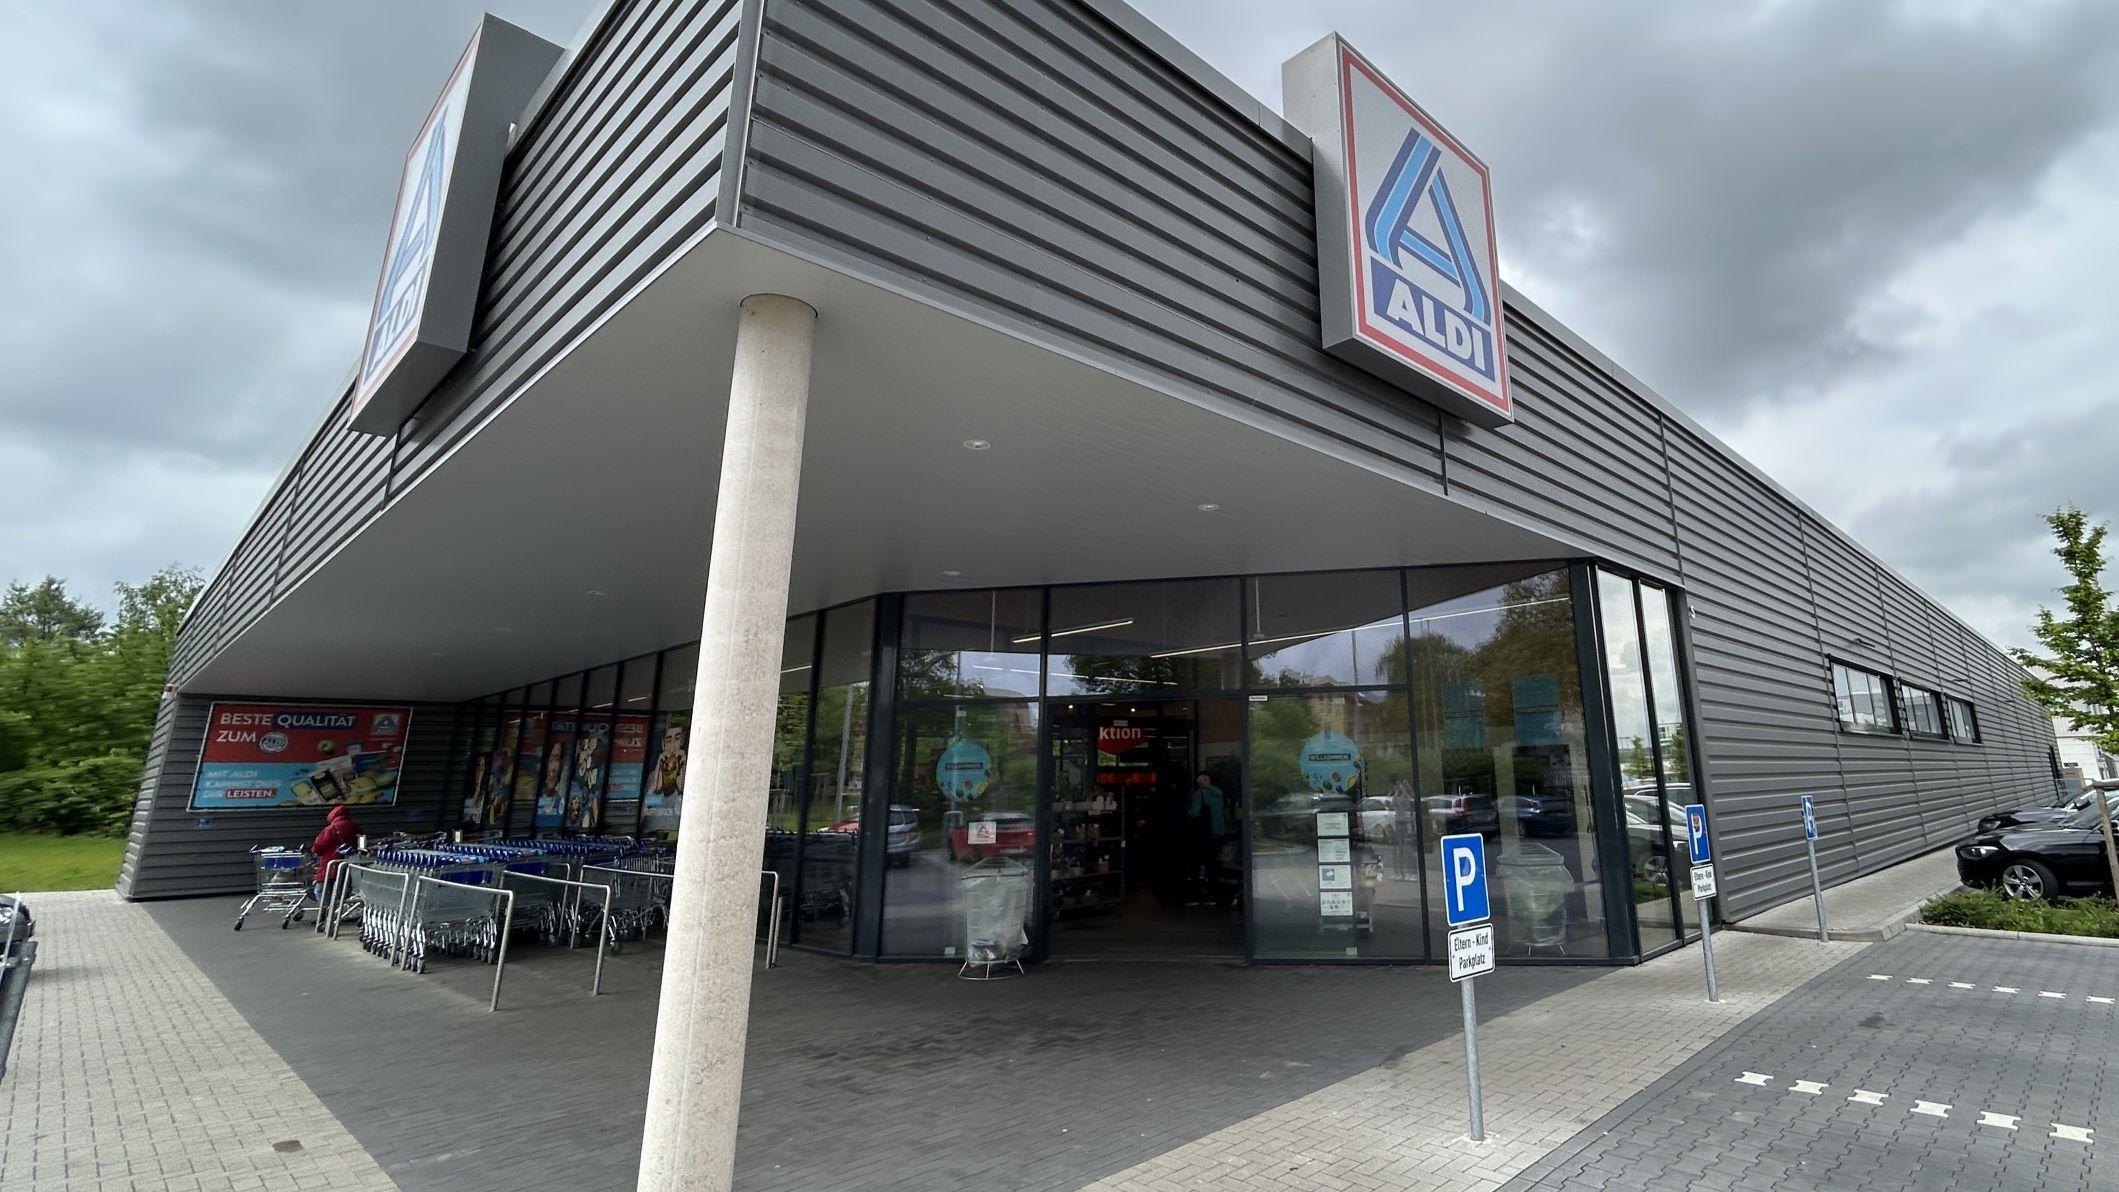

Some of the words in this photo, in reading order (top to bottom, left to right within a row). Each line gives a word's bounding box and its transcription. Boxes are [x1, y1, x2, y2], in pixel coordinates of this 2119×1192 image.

[379, 267, 423, 355] ALDI
[1386, 278, 1485, 371] ALDI
[216, 730, 257, 742] ZUM
[220, 713, 274, 725] BESTE
[277, 713, 356, 728] QUALITÄT
[1690, 813, 1703, 855] P
[1453, 847, 1476, 912] P
[1454, 936, 1472, 952] Eltern
[1476, 932, 1489, 947] Kind
[1459, 954, 1486, 971] Parkplatz
